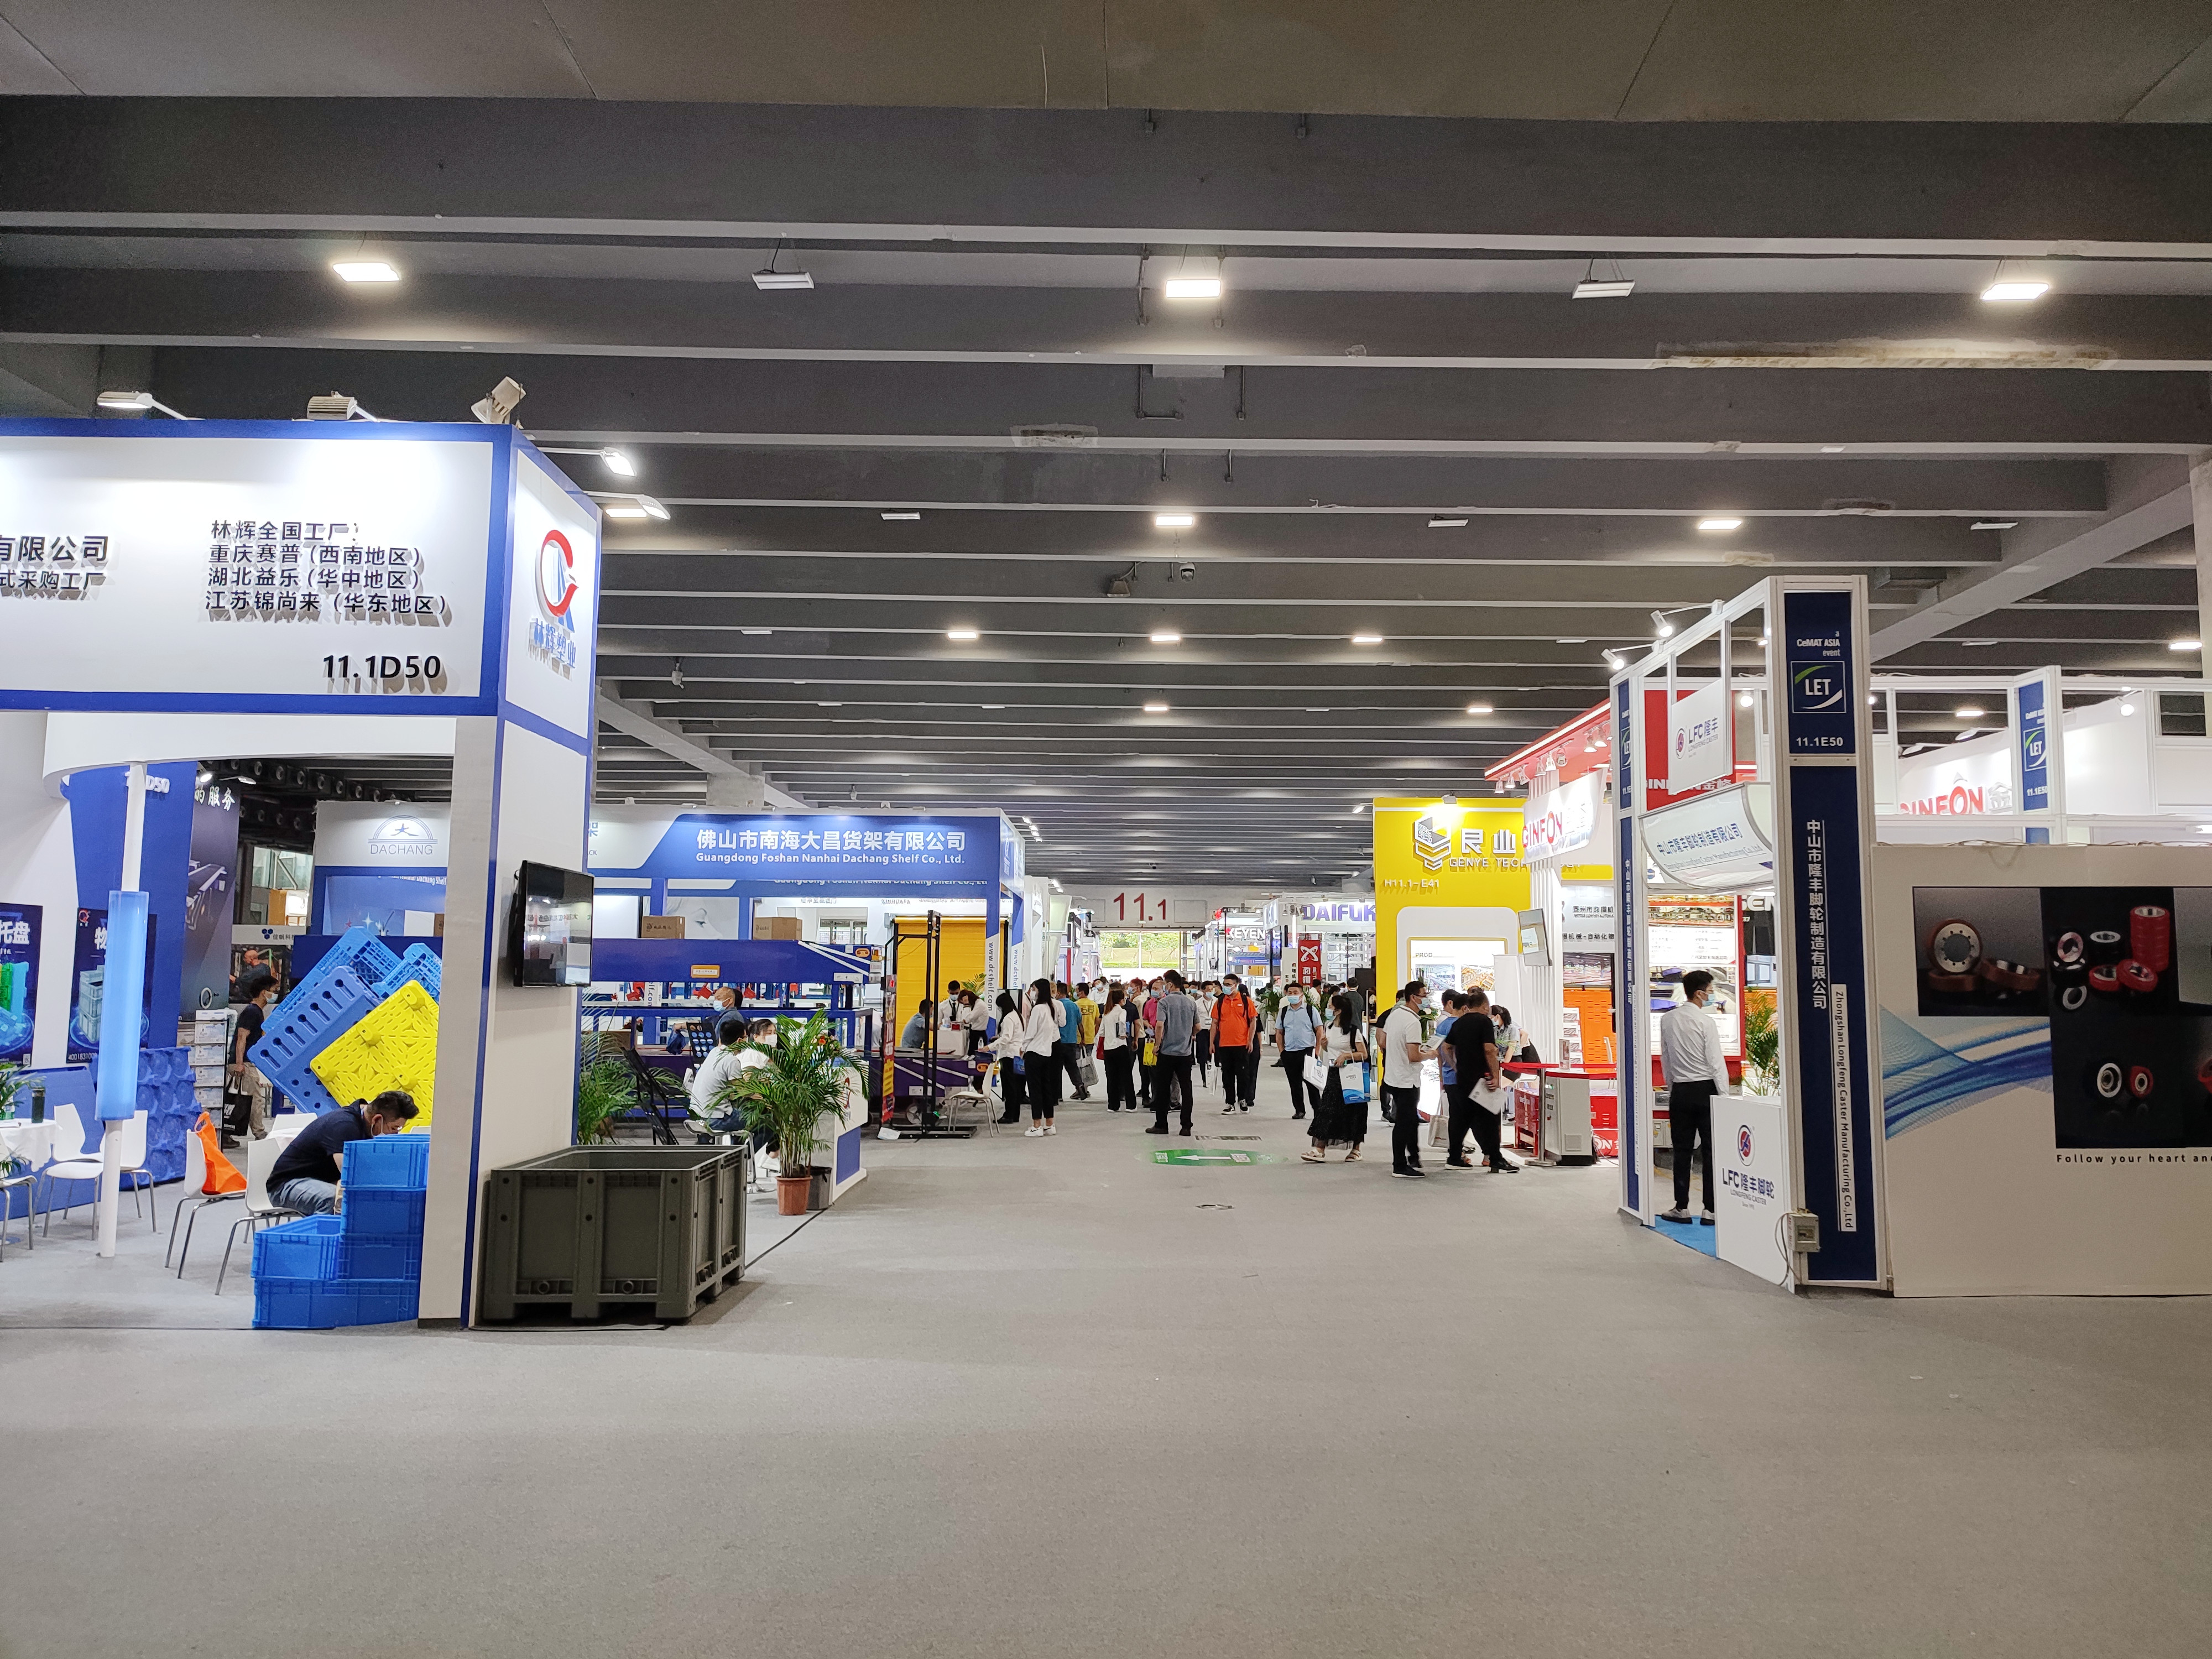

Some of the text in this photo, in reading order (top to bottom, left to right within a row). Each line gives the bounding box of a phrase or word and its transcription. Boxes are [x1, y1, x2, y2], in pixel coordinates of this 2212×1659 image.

[0, 535, 108, 561] 有限公司
[533, 618, 576, 669] 林辉塑业
[1796, 638, 1840, 648] CeMAT ASIA
[1822, 649, 1840, 657] event
[323, 655, 441, 679] 11.1D50
[1804, 679, 1832, 696] LET
[1688, 723, 1703, 744] LFC
[1796, 737, 1843, 747] 11.1E50
[2030, 740, 2043, 757] LET
[697, 829, 966, 851] 佛山市南海大昌货架有限公司
[1522, 811, 1563, 849] GINFON
[370, 844, 433, 855] DACHANG
[696, 852, 965, 865] Guangdong Foshan Nanhai Dachang Shelf Co., Ltd.
[1449, 858, 1489, 868] GENYE
[1113, 893, 1166, 921] 11.1
[1806, 820, 1827, 1009] 中山市隆丰脚轮制造有限公司
[1835, 991, 1845, 1042] Zhongshan
[1837, 1045, 1847, 1088] Longfeng
[1839, 1090, 1848, 1120] Caster
[1841, 1123, 1851, 1193] Manufacturing
[2057, 1154, 2104, 1163] Follow
[2111, 1155, 2142, 1165] your
[2149, 1154, 2185, 1162] heart
[1722, 1167, 1775, 1199] LFC 隆丰脚轮
